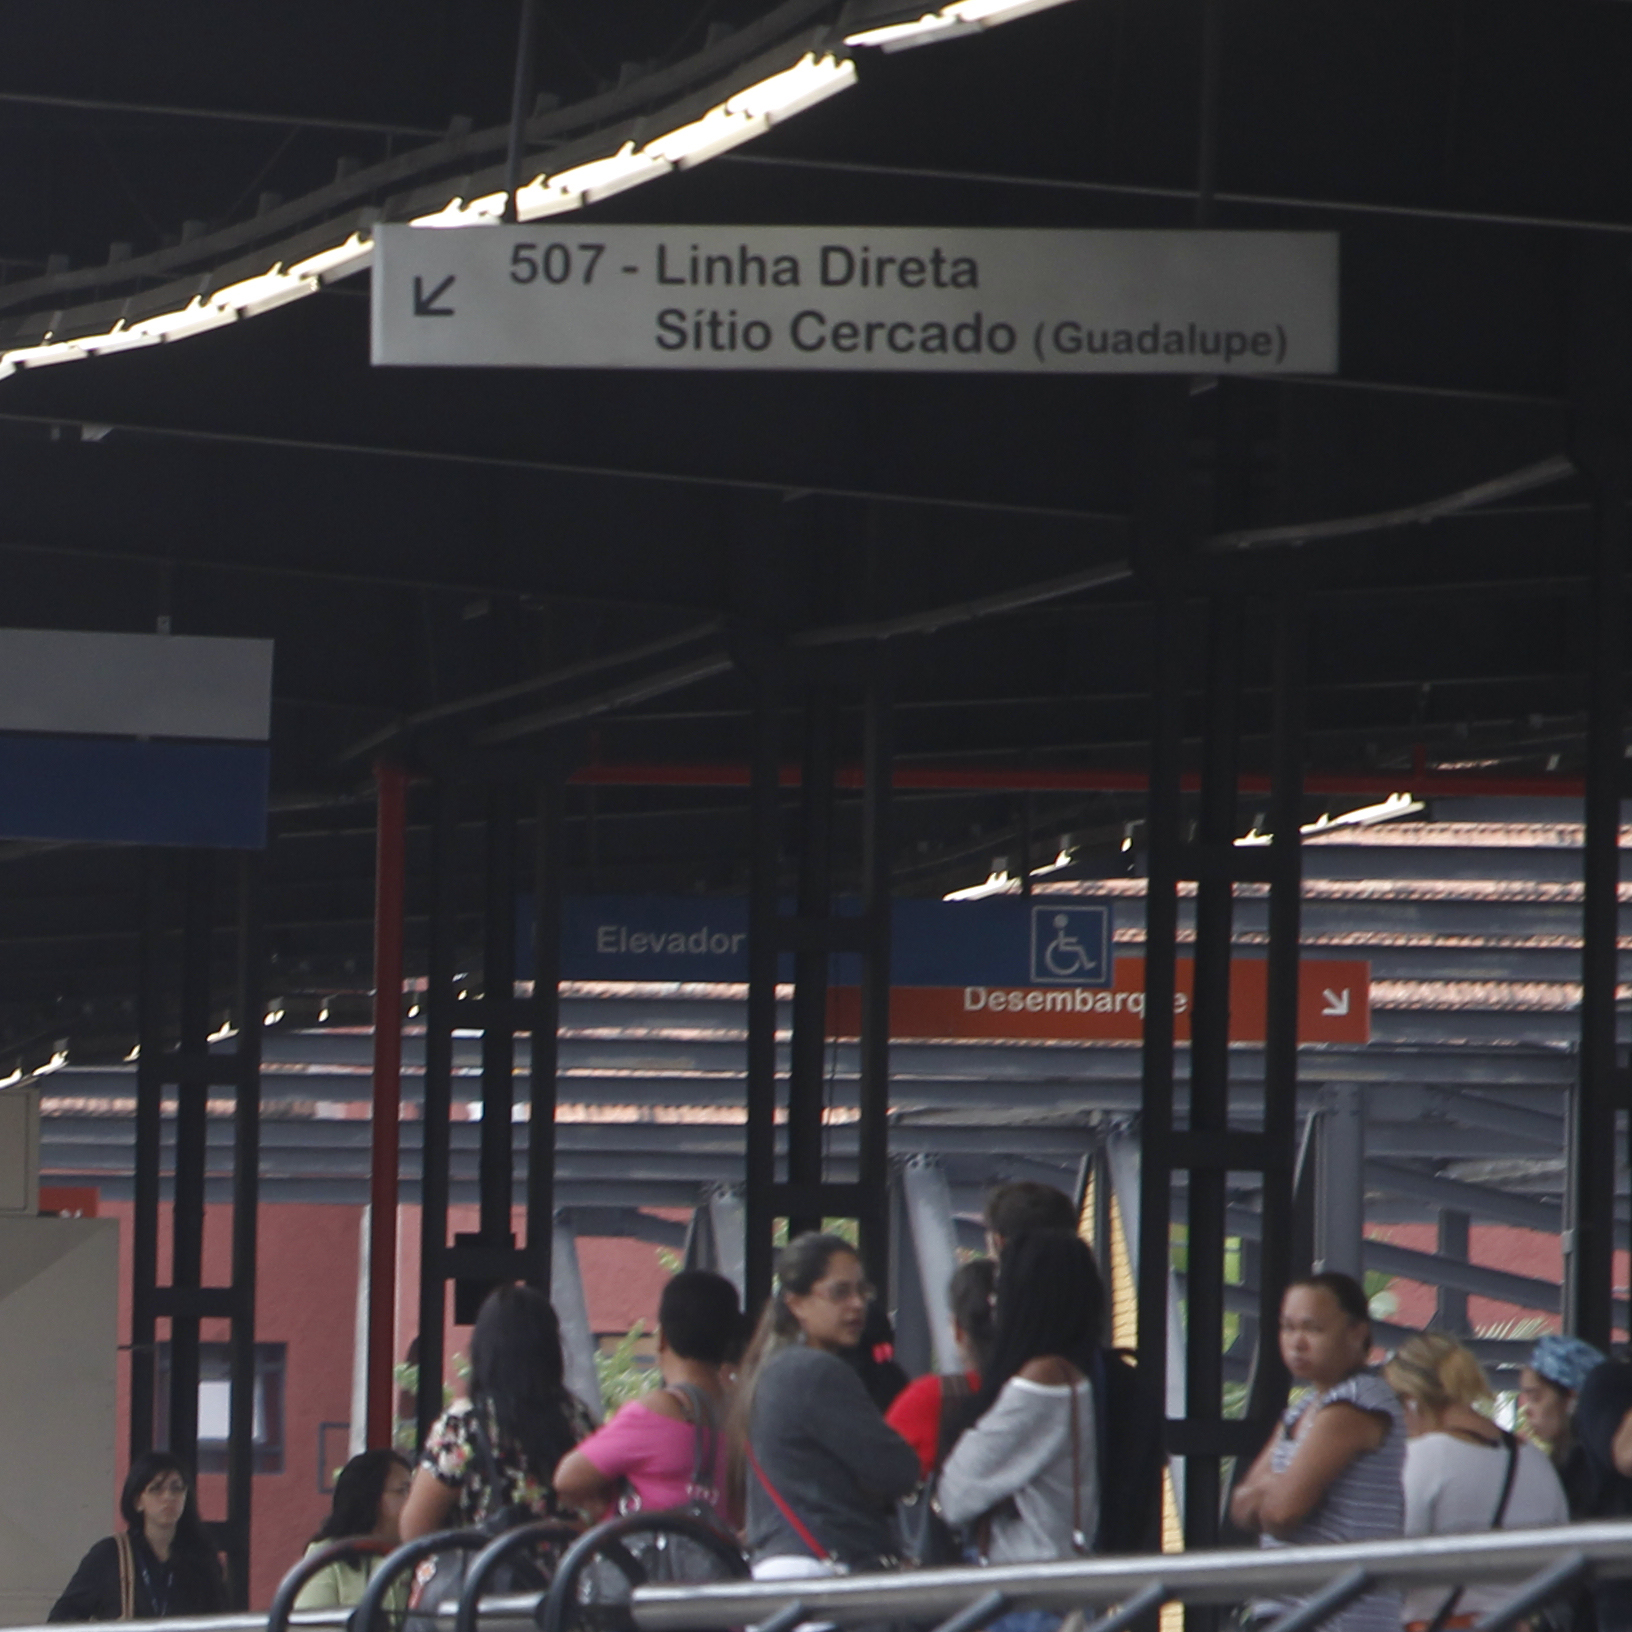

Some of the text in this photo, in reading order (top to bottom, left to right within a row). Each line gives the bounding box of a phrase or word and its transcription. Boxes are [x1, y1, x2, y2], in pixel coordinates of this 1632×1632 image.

[510, 242, 606, 285] 507
[657, 244, 800, 287] Linha
[821, 245, 979, 289] Direta
[656, 308, 1287, 365] Sítio Cercado (Guadalupe)
[597, 925, 746, 954] Elevador
[965, 987, 1187, 1019] Desembarqe
